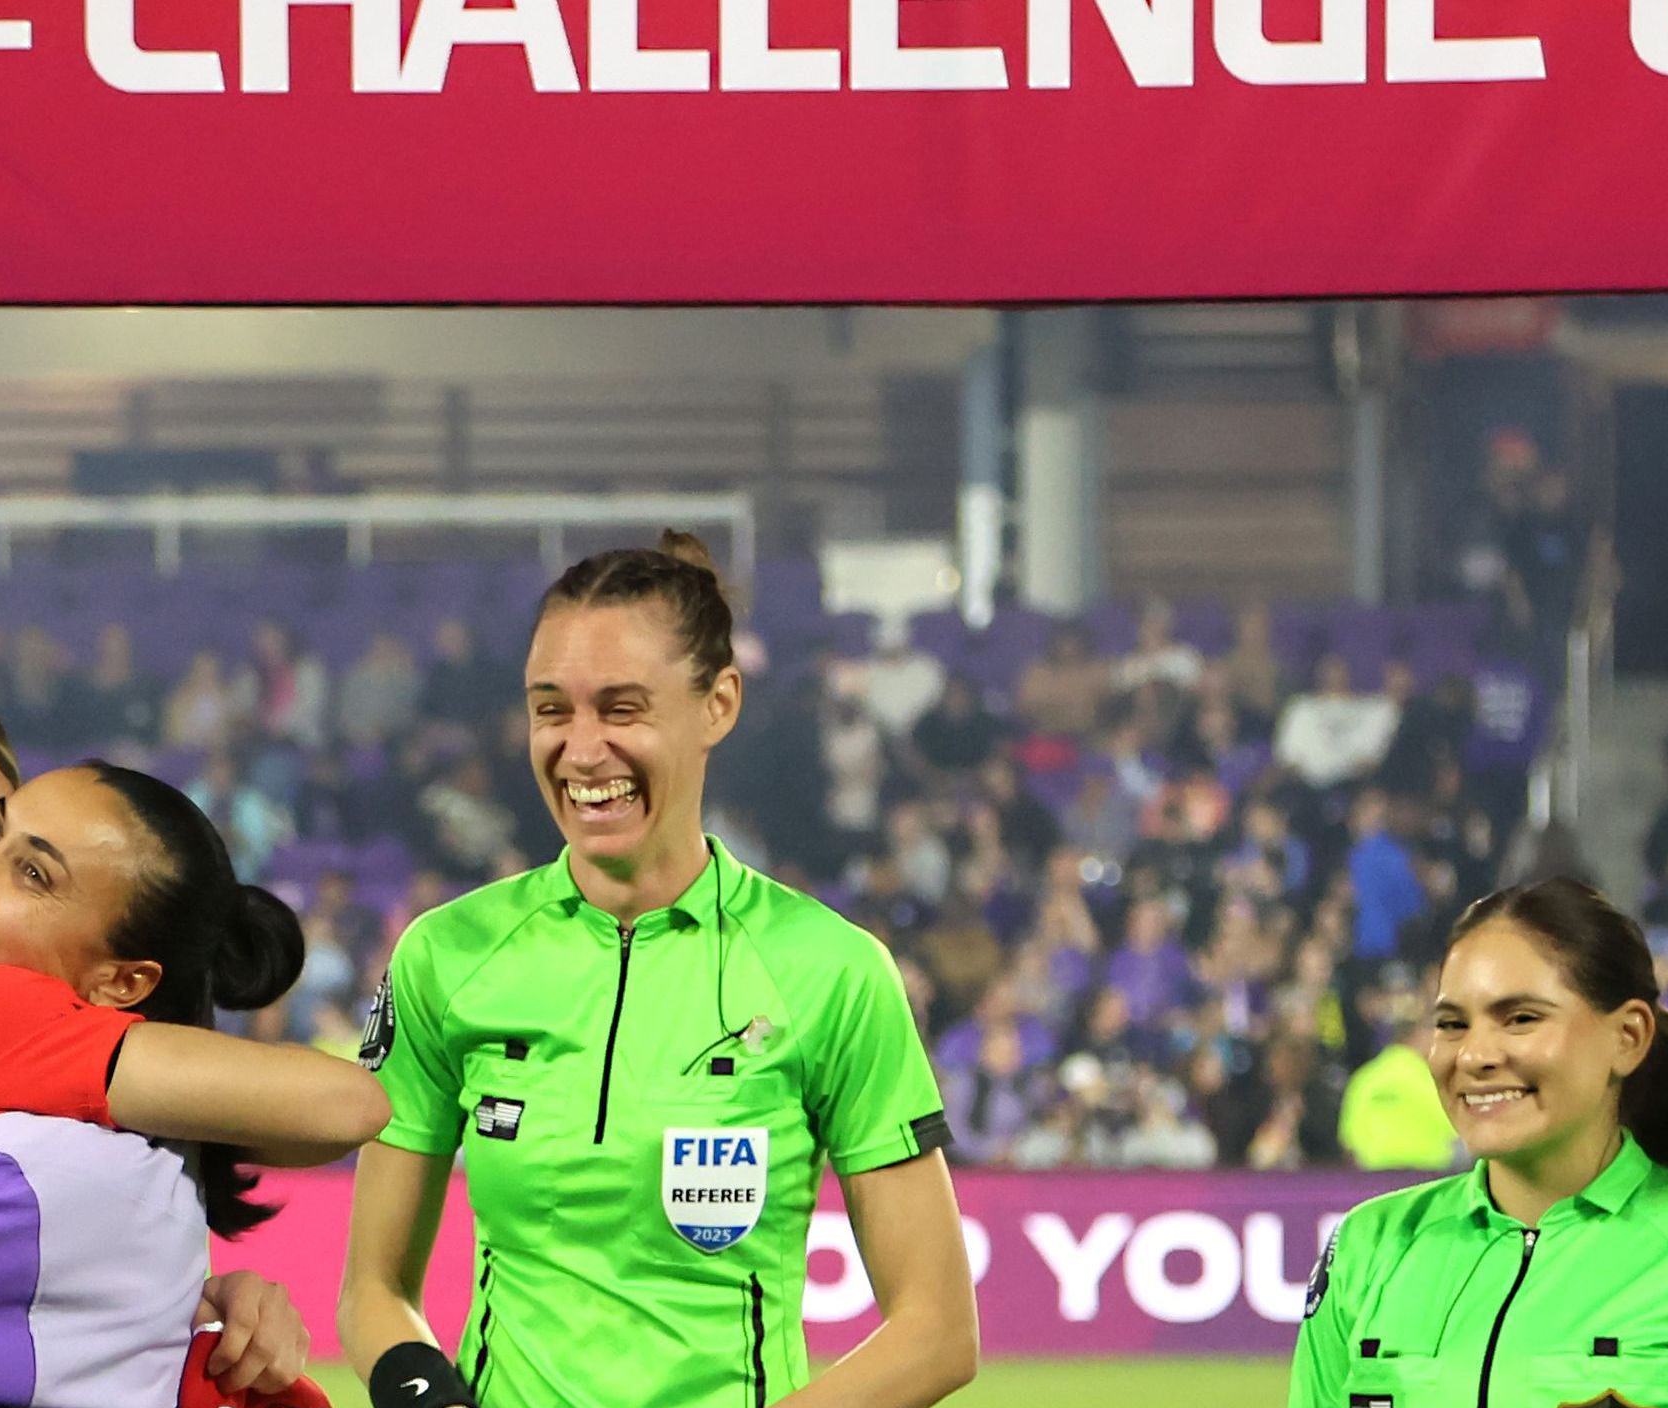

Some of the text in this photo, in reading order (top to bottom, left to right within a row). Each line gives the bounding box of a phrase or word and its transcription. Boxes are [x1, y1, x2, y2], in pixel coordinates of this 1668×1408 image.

[673, 1137, 758, 1167] FIFA
[672, 1187, 757, 1204] REFEREE
[691, 1228, 733, 1242] 2025
